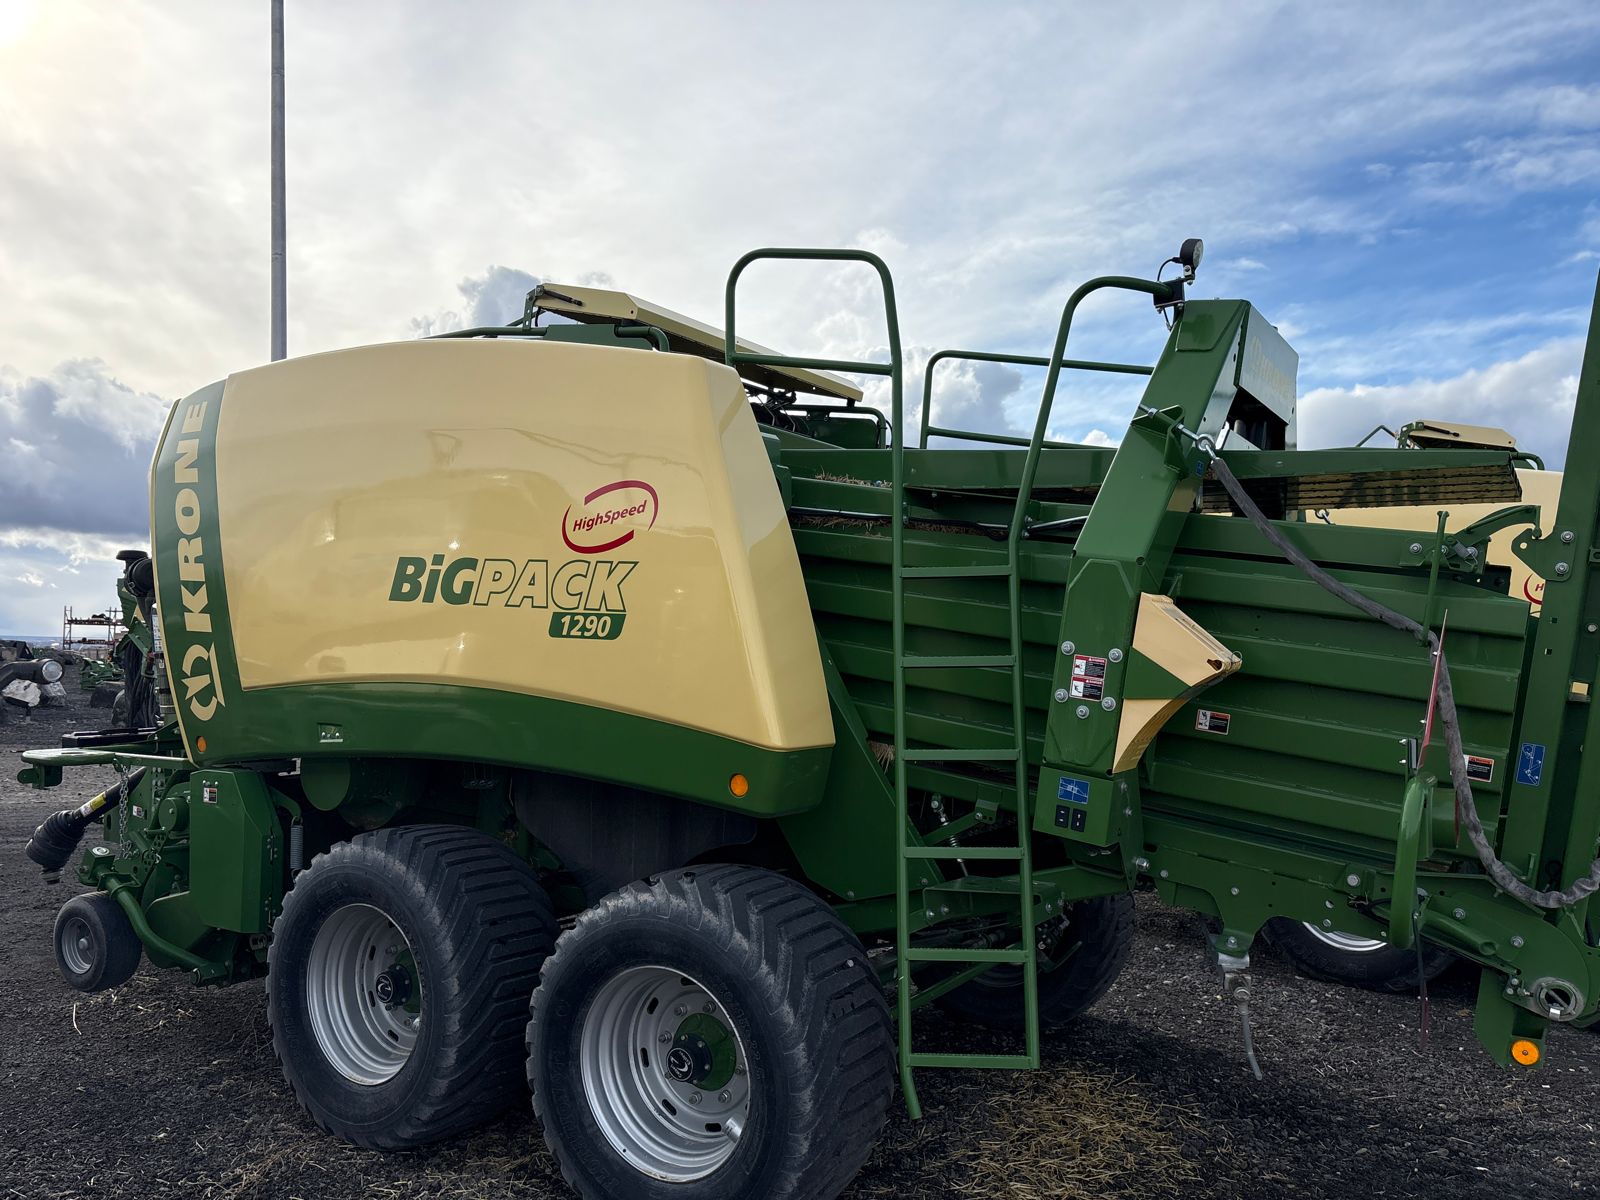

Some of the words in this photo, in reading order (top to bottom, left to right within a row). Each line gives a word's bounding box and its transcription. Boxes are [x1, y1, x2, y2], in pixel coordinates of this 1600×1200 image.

[174, 401, 213, 634] KRONE
[572, 500, 648, 532] HighSpeed
[560, 614, 612, 637] 1290
[551, 1086, 620, 1194] FLOTATION
